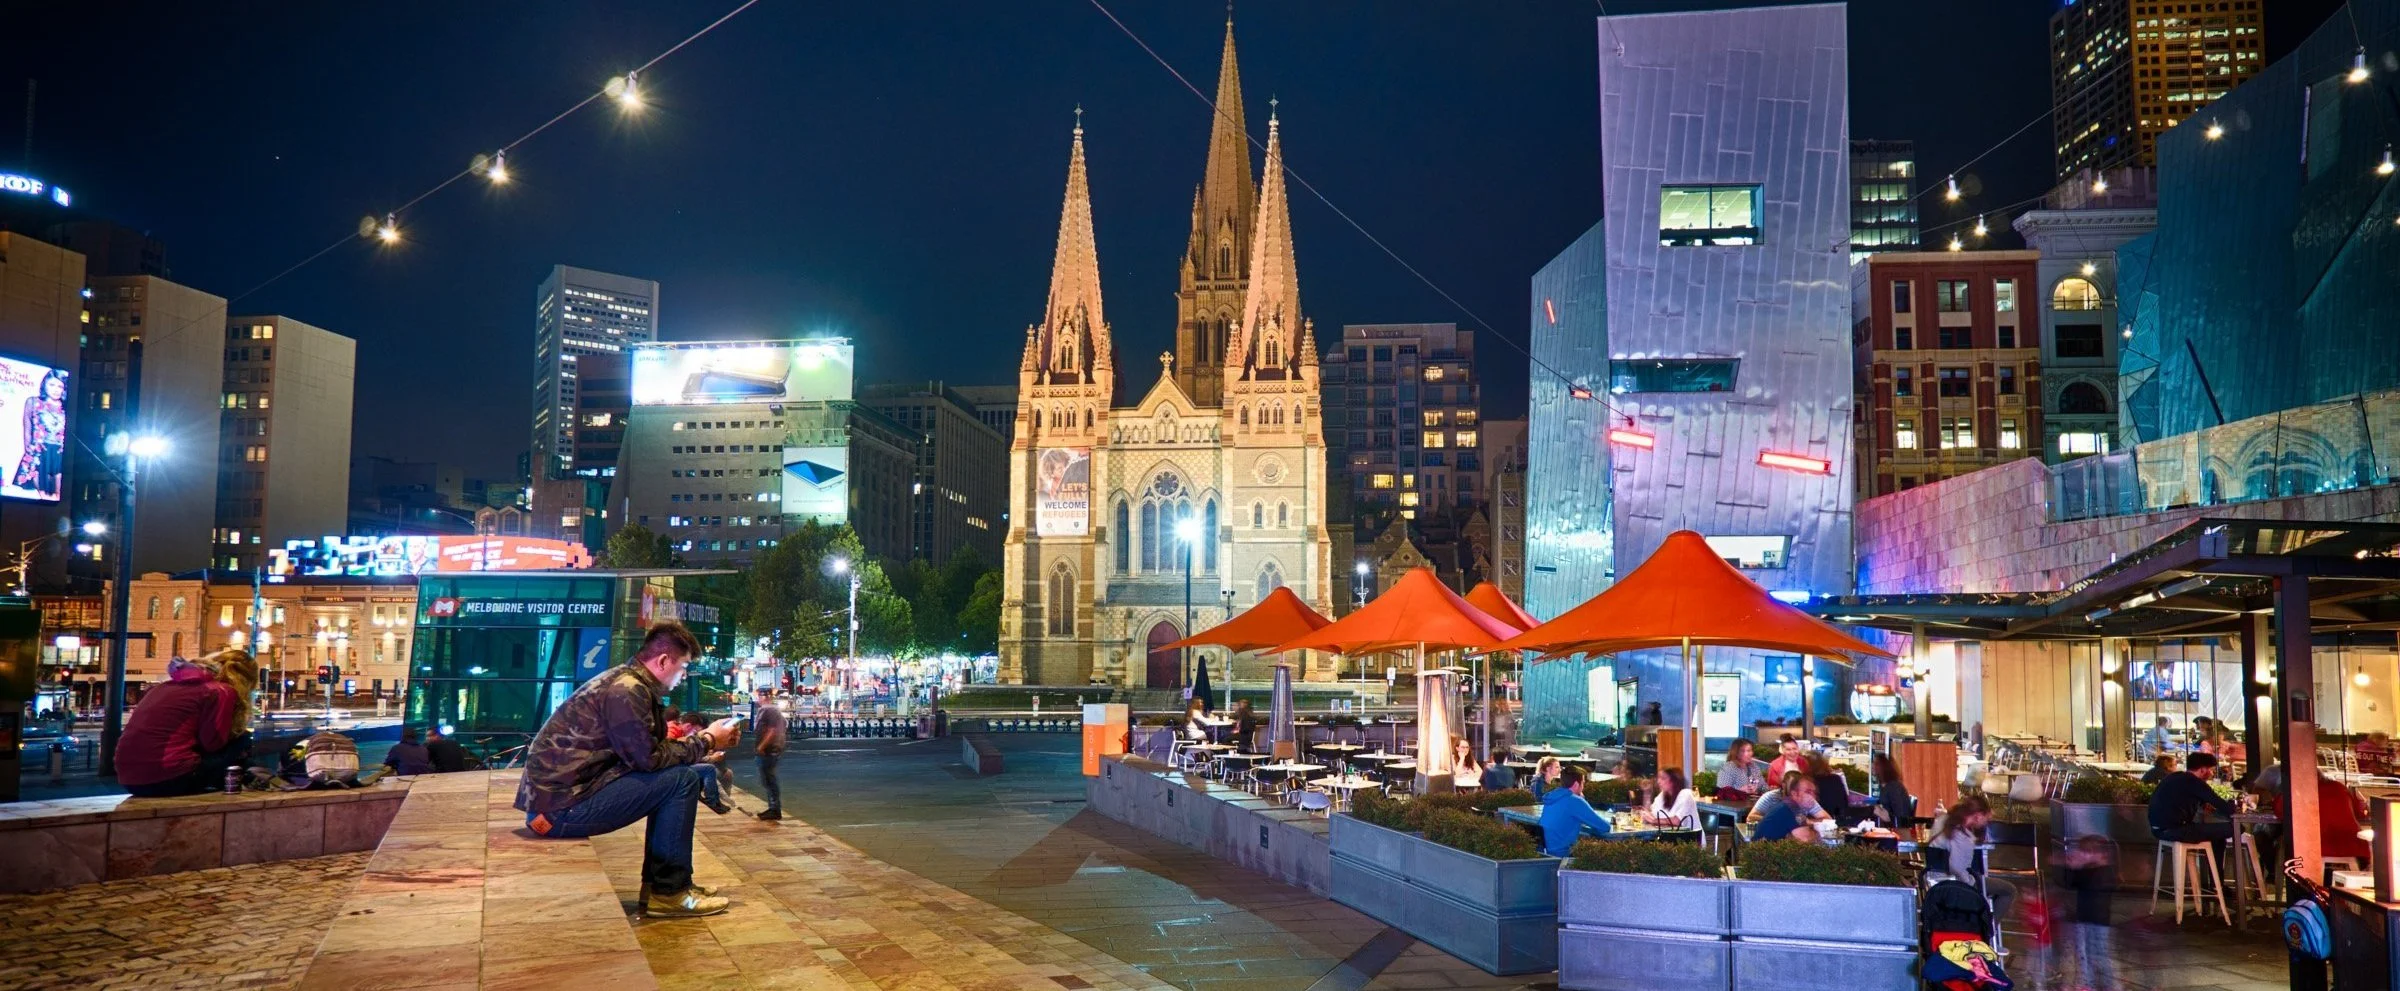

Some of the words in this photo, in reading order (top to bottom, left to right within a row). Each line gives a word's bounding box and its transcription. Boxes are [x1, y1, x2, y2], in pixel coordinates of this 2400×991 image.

[1061, 482, 1087, 492] LET'S
[1058, 492, 1087, 500] FULLY
[1044, 501, 1087, 509] WELCOME
[1042, 510, 1087, 518] REFUGEES
[466, 602, 524, 613] MELBOURNE
[528, 603, 564, 614] VISITOR
[568, 603, 605, 614] CENTRE
[659, 598, 687, 620] MELBOURNE
[688, 603, 704, 622] VISITOR
[705, 606, 719, 624] CENTRE
[2363, 753, 2374, 761] OUT
[2376, 755, 2388, 763] TIME
